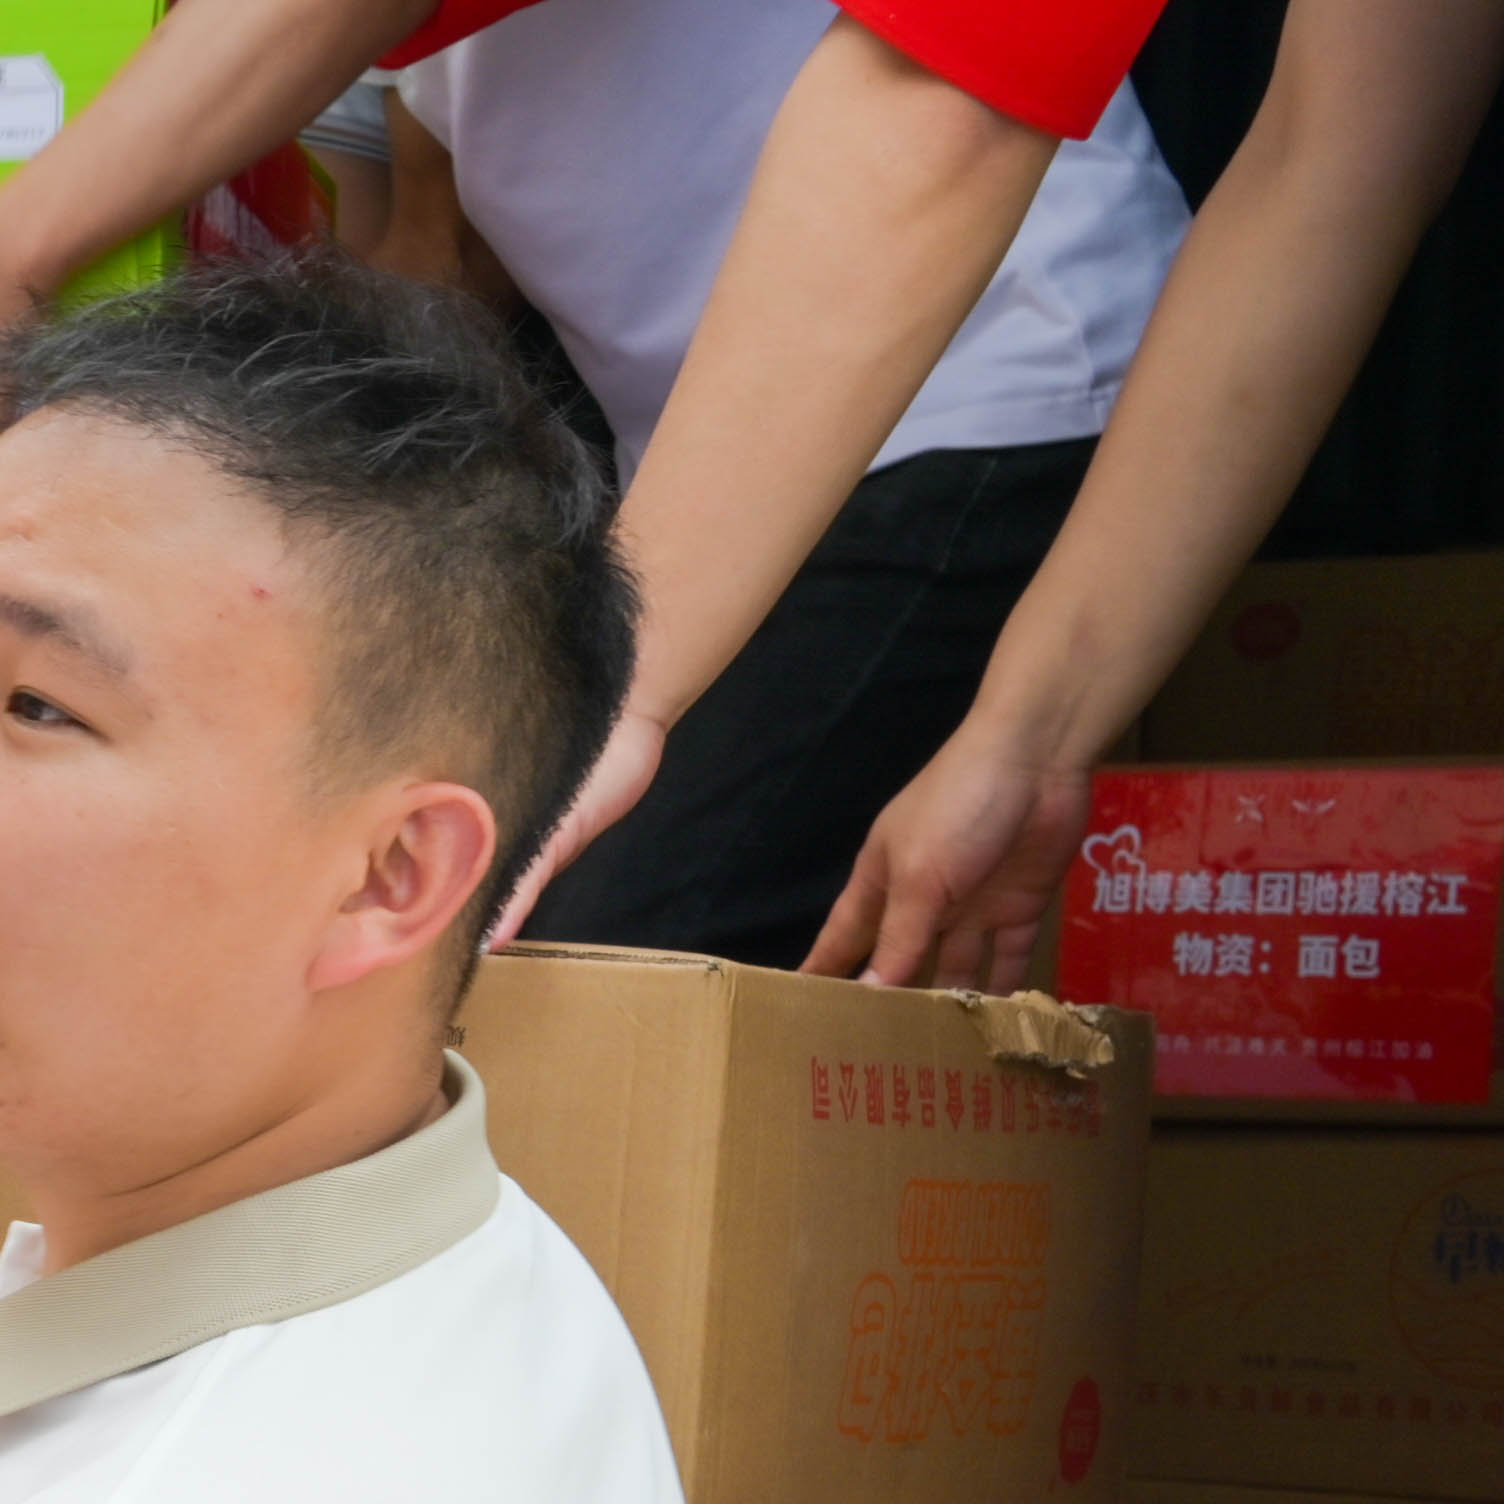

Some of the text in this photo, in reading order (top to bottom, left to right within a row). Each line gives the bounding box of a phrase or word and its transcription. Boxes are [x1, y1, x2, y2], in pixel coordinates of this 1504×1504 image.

[1093, 870, 1468, 916] 旭博美集团驰援榕江
